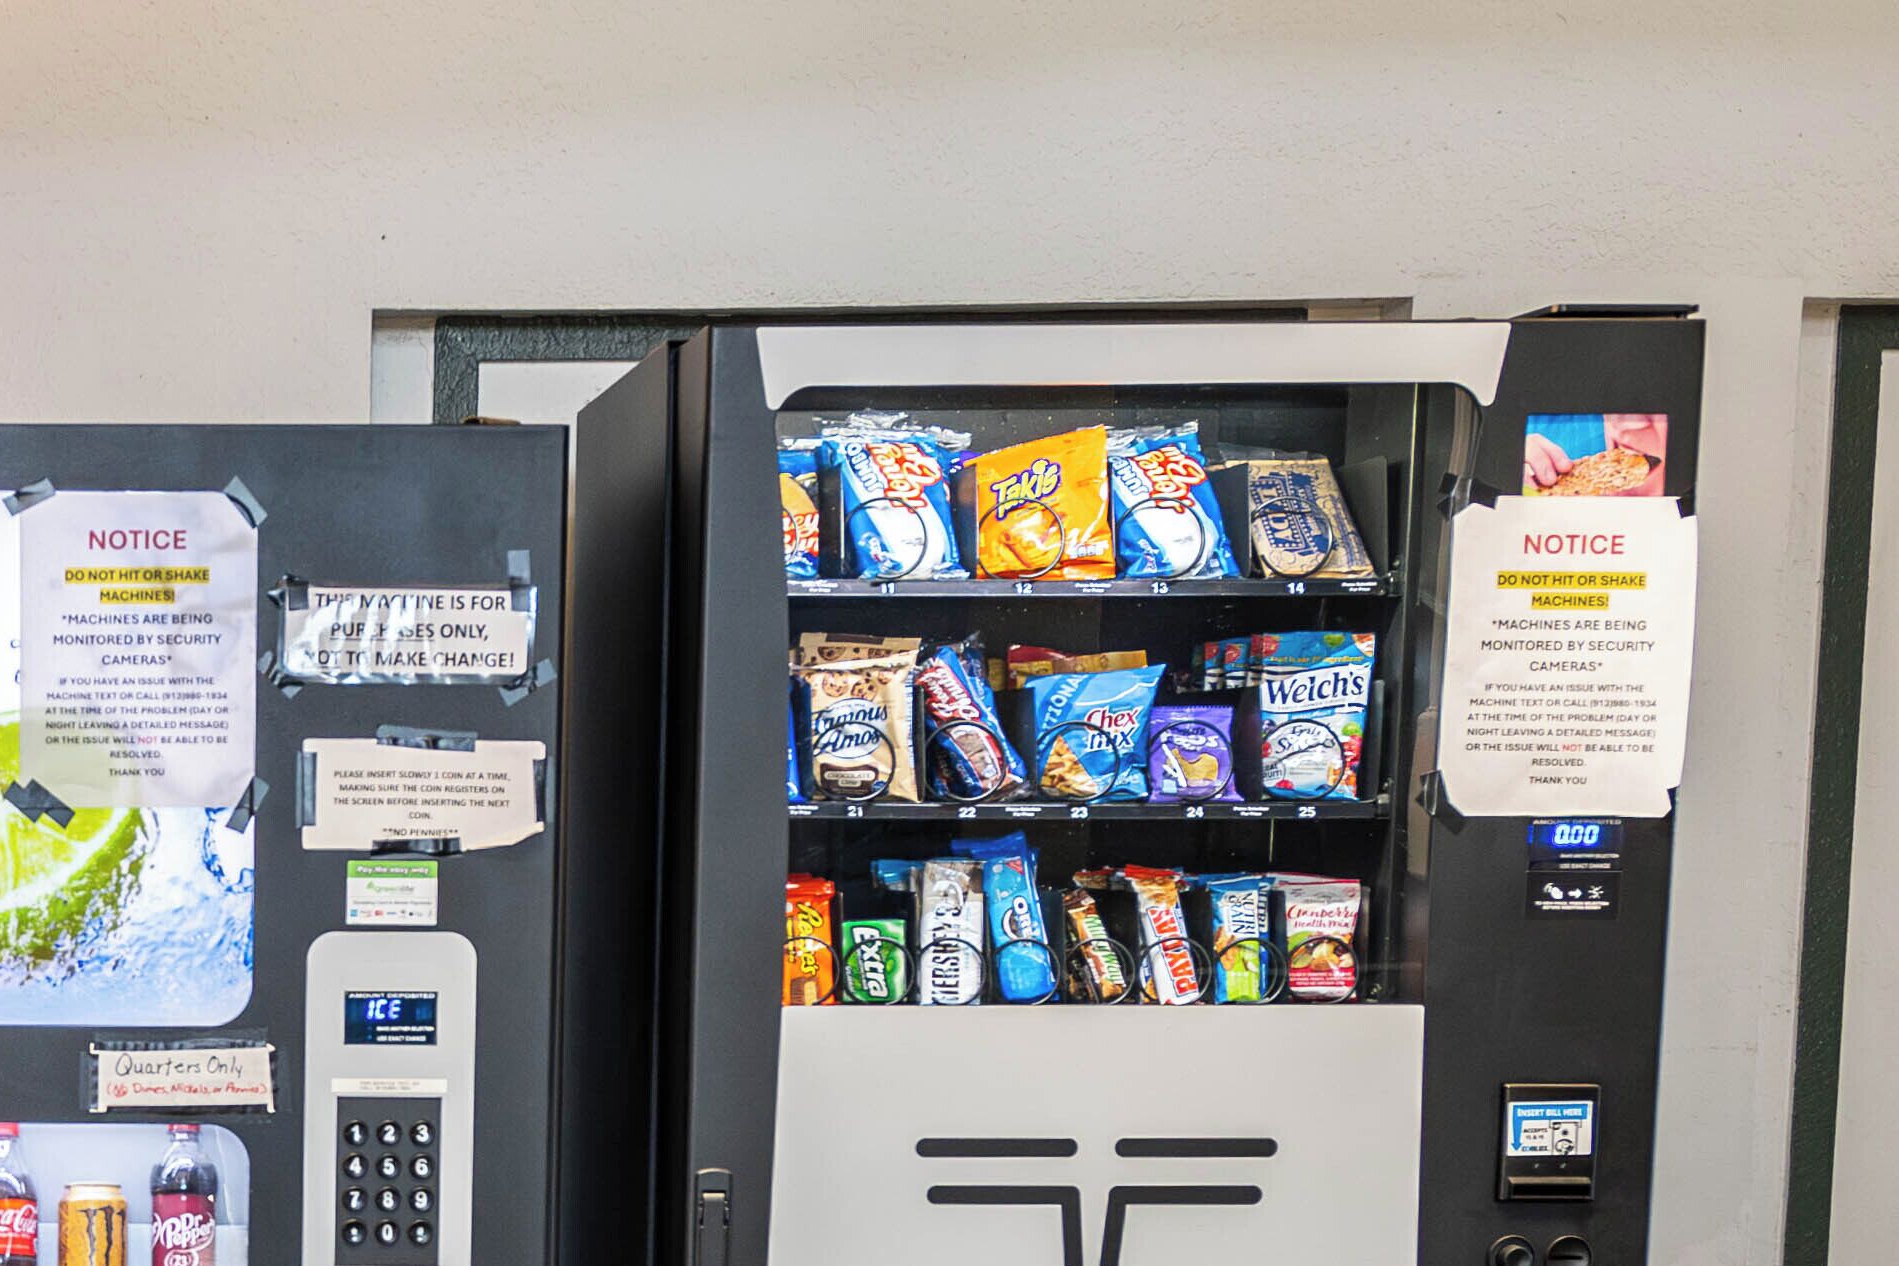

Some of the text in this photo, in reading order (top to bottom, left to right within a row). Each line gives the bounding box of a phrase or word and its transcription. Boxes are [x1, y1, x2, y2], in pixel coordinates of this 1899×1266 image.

[845, 442, 885, 493] JUMBO
[992, 459, 1061, 520] Takis
[89, 529, 187, 550] NOTICE
[1524, 534, 1625, 554] NOTICE
[65, 569, 210, 581] DO NOT HIT OR SHAKE
[1497, 575, 1646, 586] DO NOT HIT OR SHAKE
[100, 591, 175, 601] MACHINES!
[1152, 582, 1169, 594] 13
[1287, 582, 1305, 594] 14
[451, 595, 505, 610] IS FOR
[1532, 596, 1609, 607] MACHINES!
[142, 614, 169, 625] ARE
[172, 614, 213, 625] BEING
[1575, 620, 1600, 630] ARE
[1605, 620, 1647, 630] BEING
[53, 634, 221, 645] MONITORED BY SECURITY
[440, 624, 489, 641] ONLY,
[1481, 640, 1655, 651] MONITORED BY SECURITY
[375, 651, 514, 668] MAKE CHANGE!
[1266, 671, 1365, 705] Welch's
[812, 704, 888, 735] Famous
[1086, 708, 1139, 731] Chex
[820, 729, 881, 753] Amos
[1089, 728, 1134, 751] mix
[334, 770, 363, 778] PLEASE
[1529, 777, 1587, 785] THANK YOU
[959, 807, 977, 818] 22
[1071, 806, 1089, 818] 23
[1187, 806, 1204, 818] 24
[1299, 806, 1316, 818] 25
[1287, 904, 1359, 921] Cranberry
[1147, 907, 1199, 996] PAYDAY
[366, 999, 401, 1020] ICE
[115, 1053, 242, 1078] Quarters Only
[182, 1213, 203, 1231] Dr
[163, 1216, 214, 1249] Pepper
